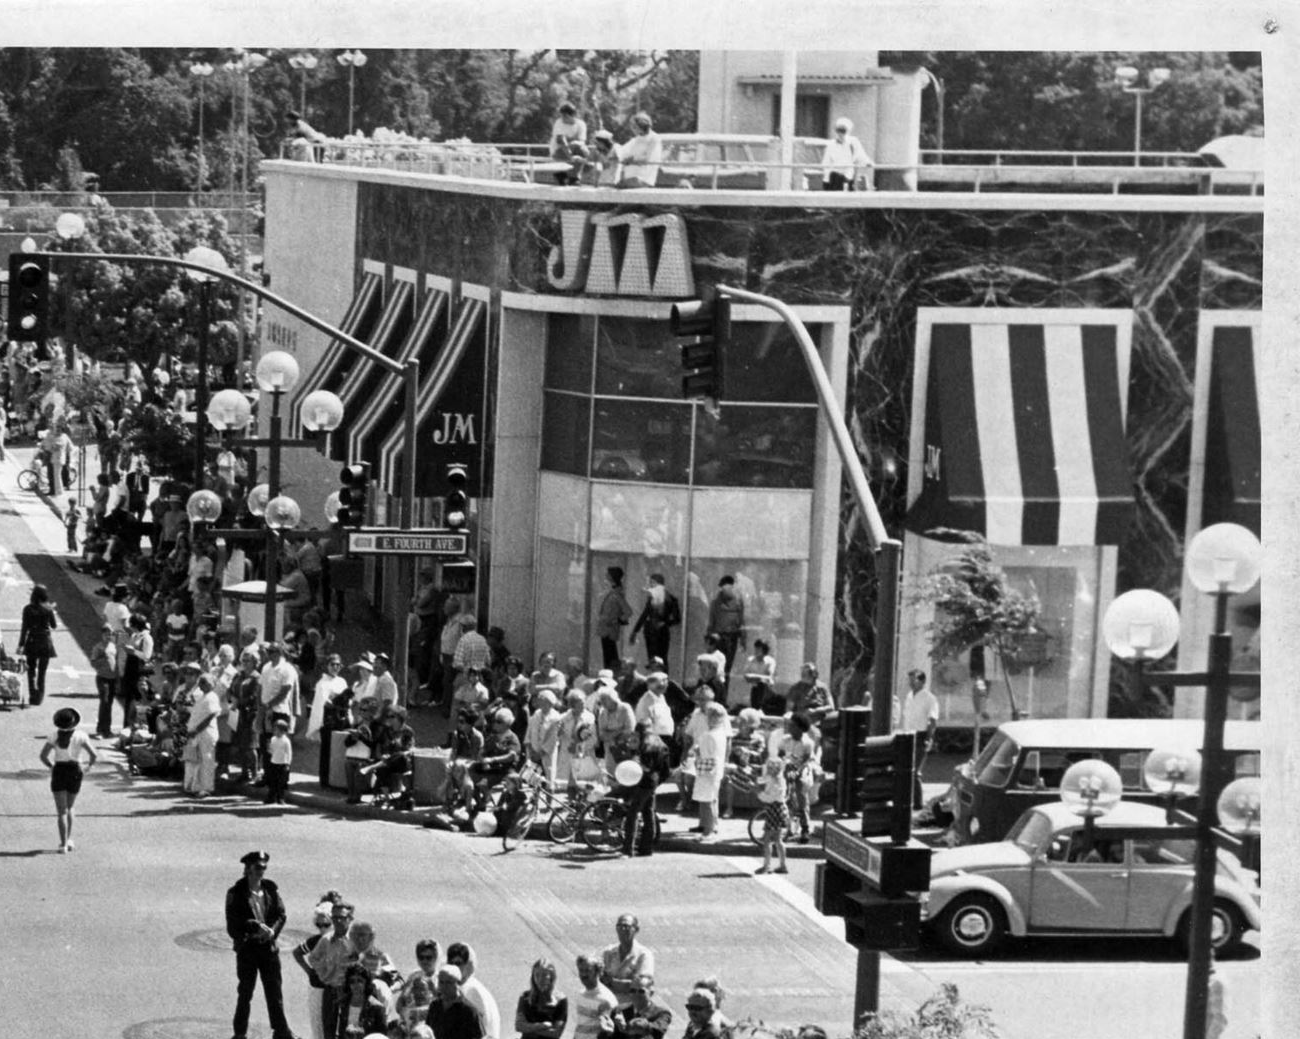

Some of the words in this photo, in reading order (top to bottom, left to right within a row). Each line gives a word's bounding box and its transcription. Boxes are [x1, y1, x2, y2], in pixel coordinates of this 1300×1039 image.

[433, 412, 477, 445] JM
[925, 444, 942, 482] JM
[394, 538, 432, 550] FOURTH
